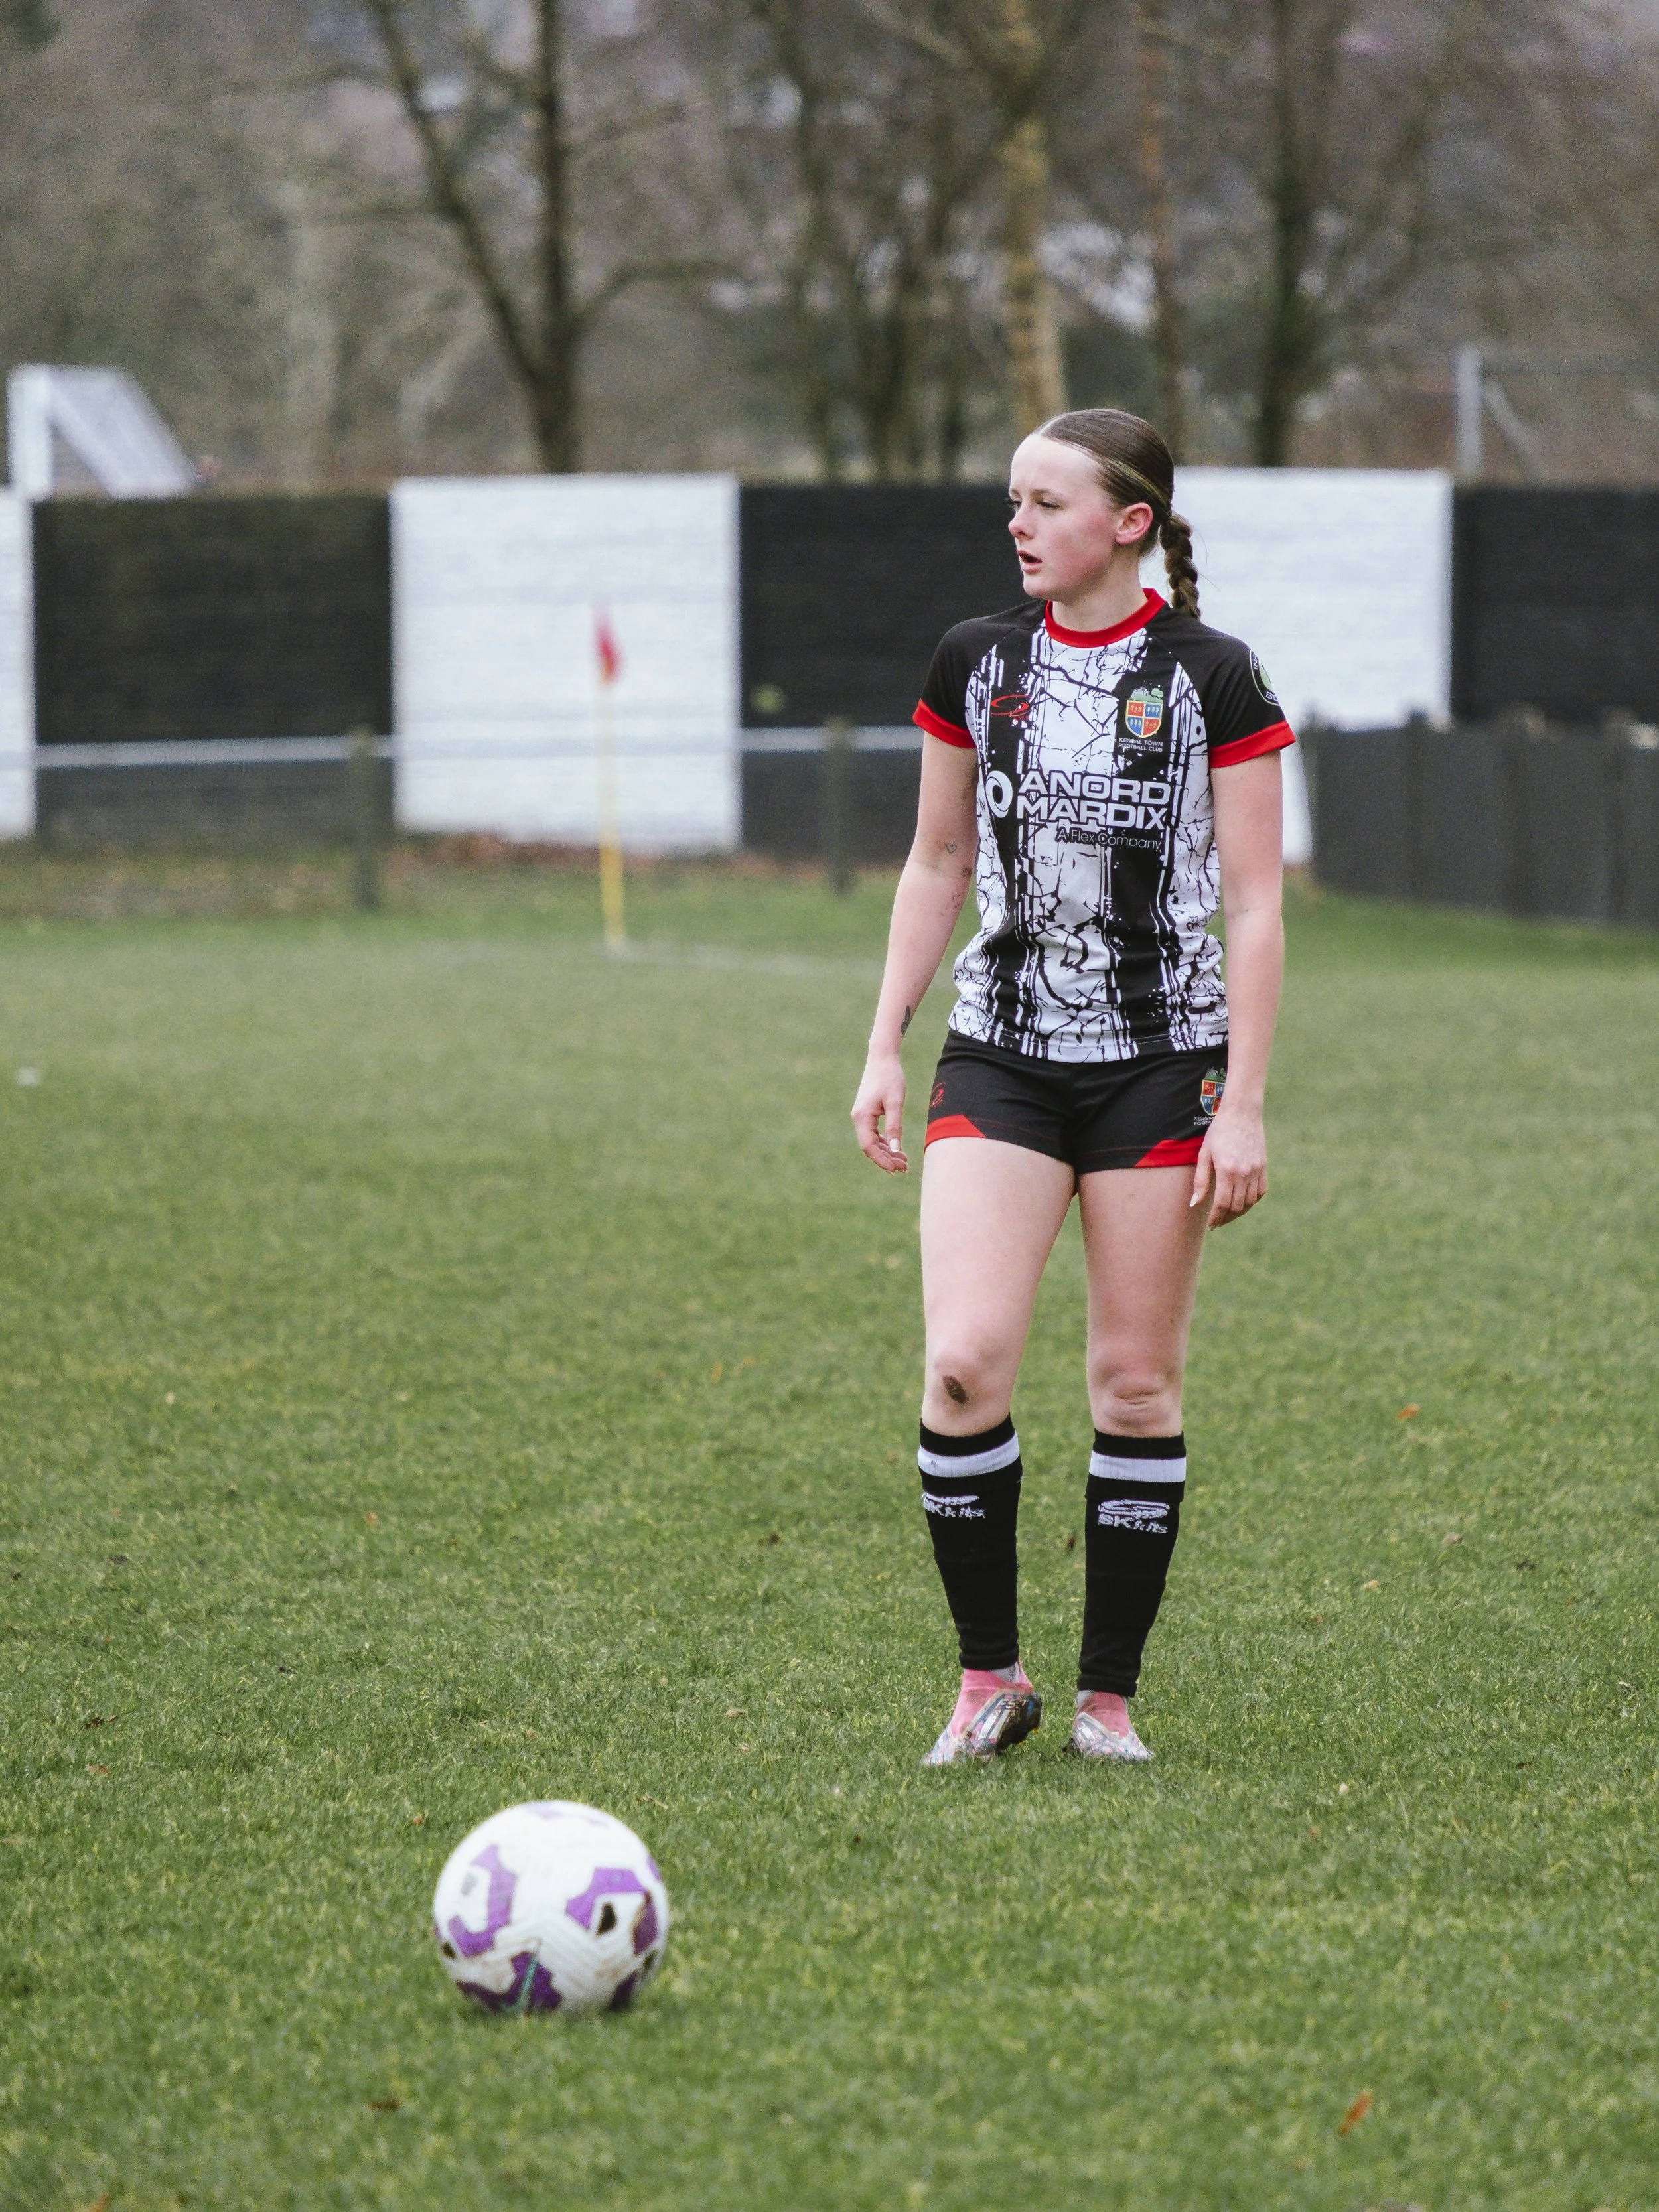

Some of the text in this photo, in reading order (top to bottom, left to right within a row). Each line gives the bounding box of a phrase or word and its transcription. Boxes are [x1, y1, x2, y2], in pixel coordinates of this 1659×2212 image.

[1019, 770, 1171, 805] ANORD
[1017, 796, 1167, 830] MARDIX
[1057, 829, 1162, 852] A Flex Company
